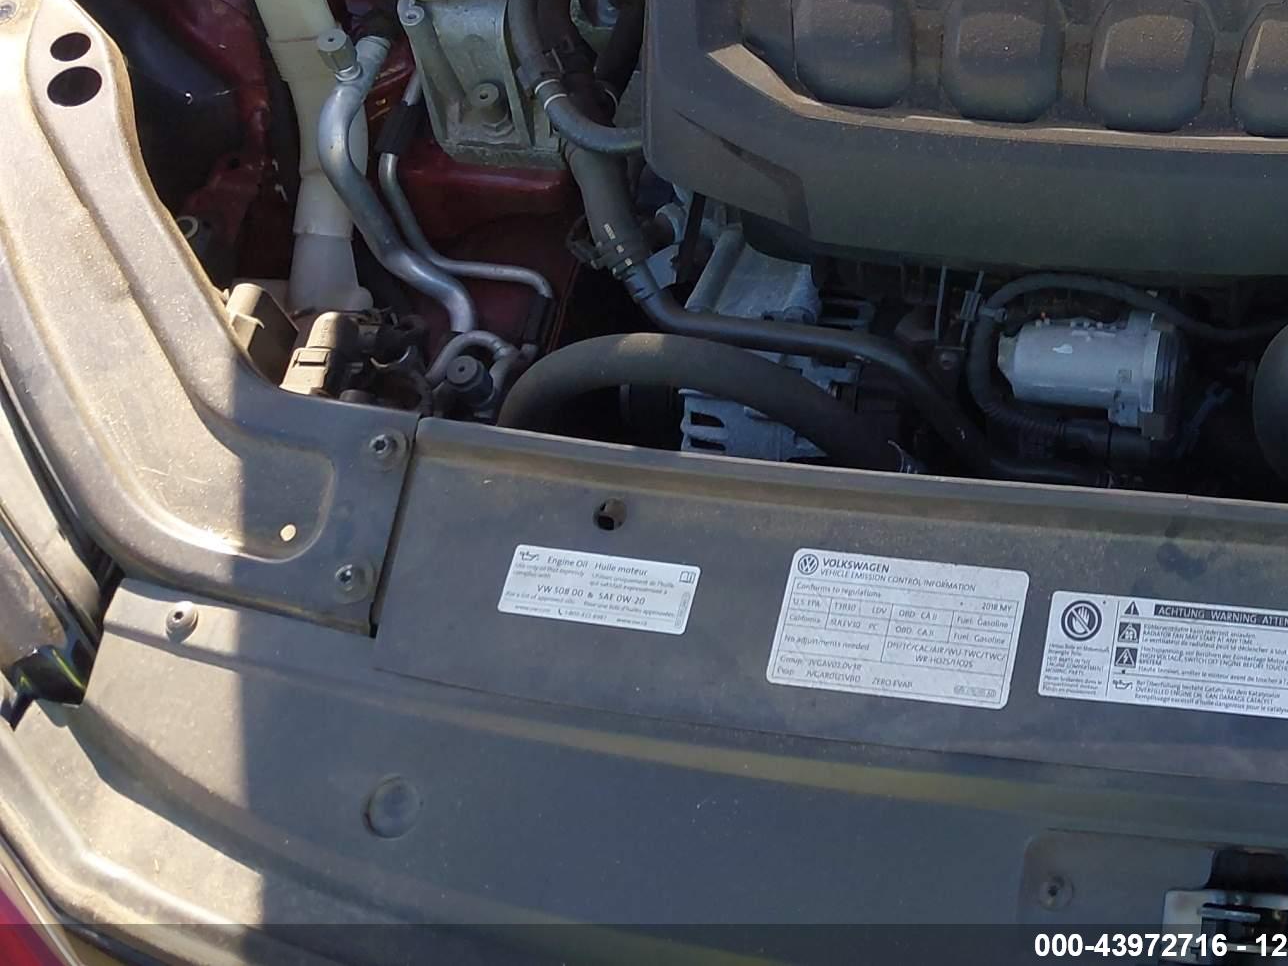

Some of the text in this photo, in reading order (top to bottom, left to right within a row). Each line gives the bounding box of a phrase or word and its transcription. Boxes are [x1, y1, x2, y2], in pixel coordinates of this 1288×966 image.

[547, 556, 588, 569] Engine Oil
[595, 563, 616, 572] Huile
[823, 557, 890, 574] VOLKSWAGEN
[820, 567, 976, 592] VEHICLE EMISSION CONTROL INFORMATION
[537, 585, 552, 594] VW
[554, 586, 571, 595] 508
[572, 589, 584, 597] 00
[598, 593, 613, 602] SAE
[797, 583, 830, 593] Conforms
[841, 587, 881, 598] regulations
[982, 602, 1012, 612] 2018 MY
[921, 611, 931, 620] CA
[1158, 605, 1205, 619] ACHTUNG
[1210, 610, 1257, 624] WARNING
[977, 618, 1008, 628] Gasoline
[917, 627, 928, 636] CA
[974, 634, 1005, 644] Gasoline
[843, 642, 870, 650] needed
[893, 679, 912, 689] EVAP
